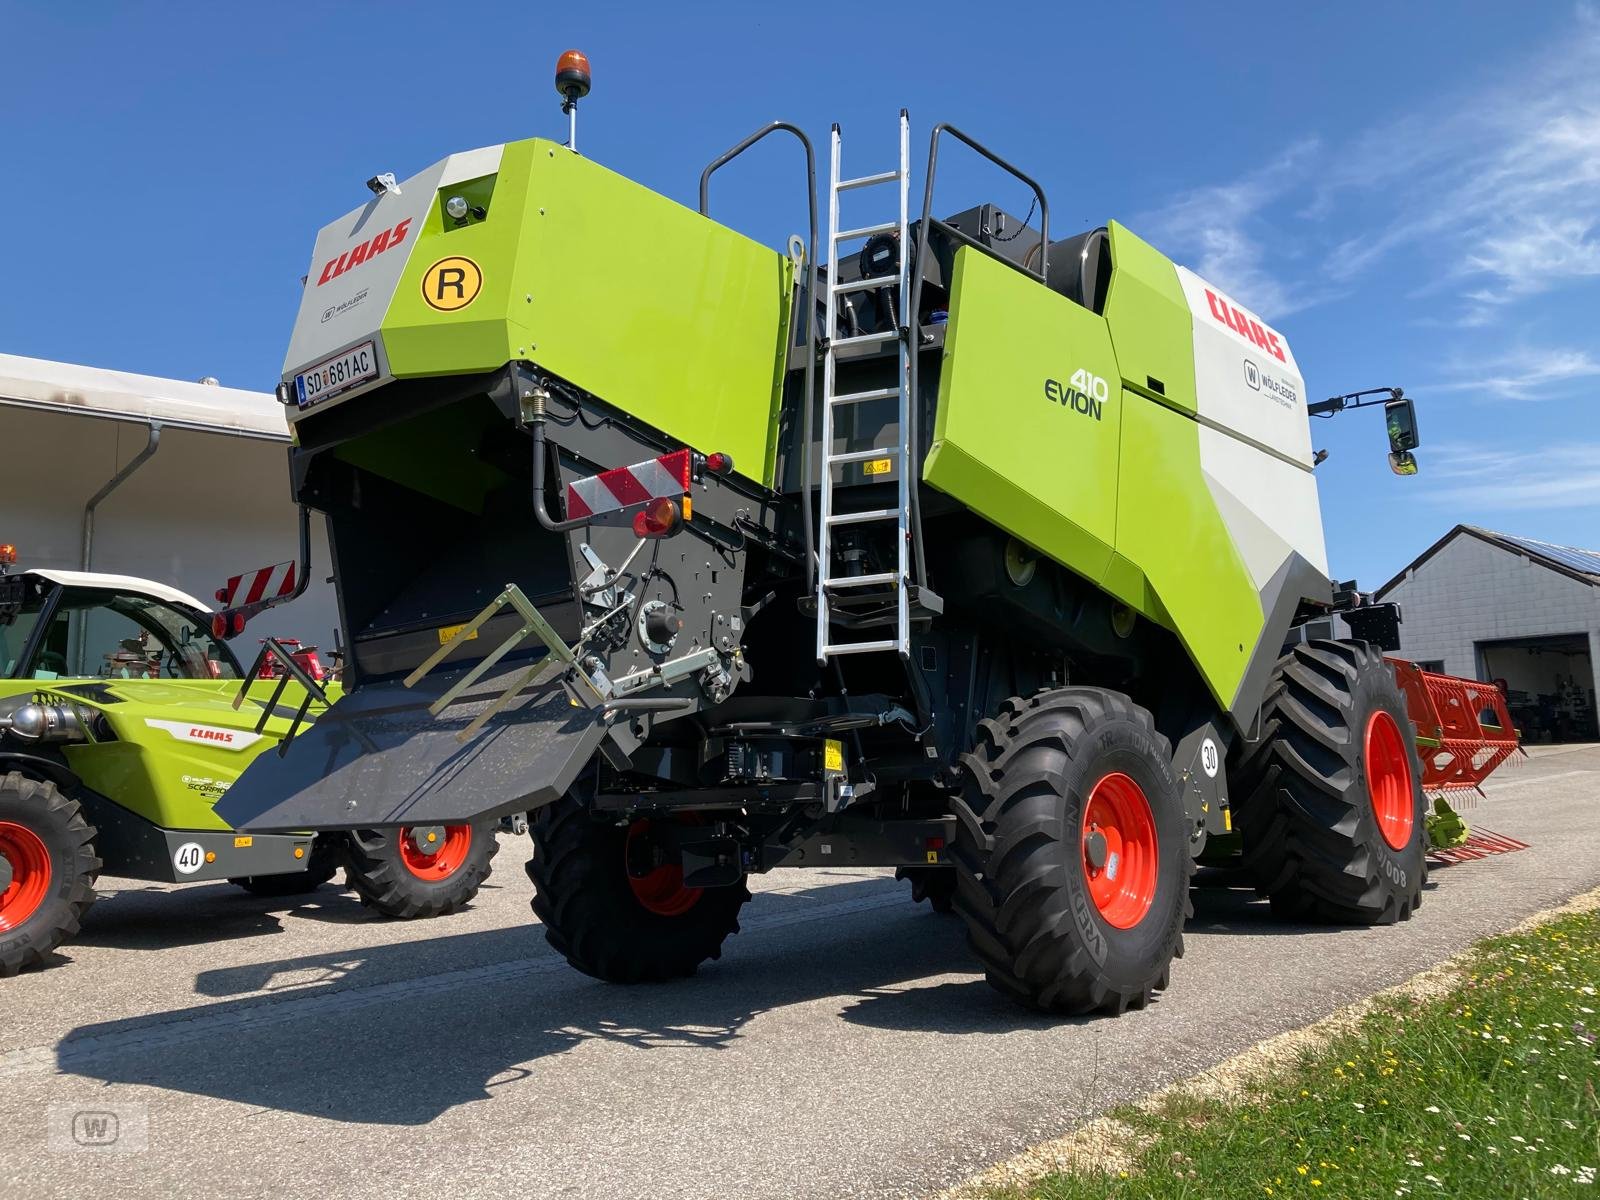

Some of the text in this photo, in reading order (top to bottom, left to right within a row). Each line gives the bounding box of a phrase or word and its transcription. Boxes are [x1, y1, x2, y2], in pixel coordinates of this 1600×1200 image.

[317, 217, 413, 287] CLAAS
[437, 267, 466, 300] R
[1204, 288, 1286, 363] CLAAS
[307, 372, 322, 395] SD
[1044, 379, 1102, 421] EVION
[1070, 368, 1108, 403] 410
[1261, 374, 1297, 402] WÖLFLEDER
[189, 728, 234, 743] CLAAS
[1204, 746, 1216, 769] 30
[179, 847, 199, 868] 40
[1064, 802, 1101, 955] VREDEEIN
